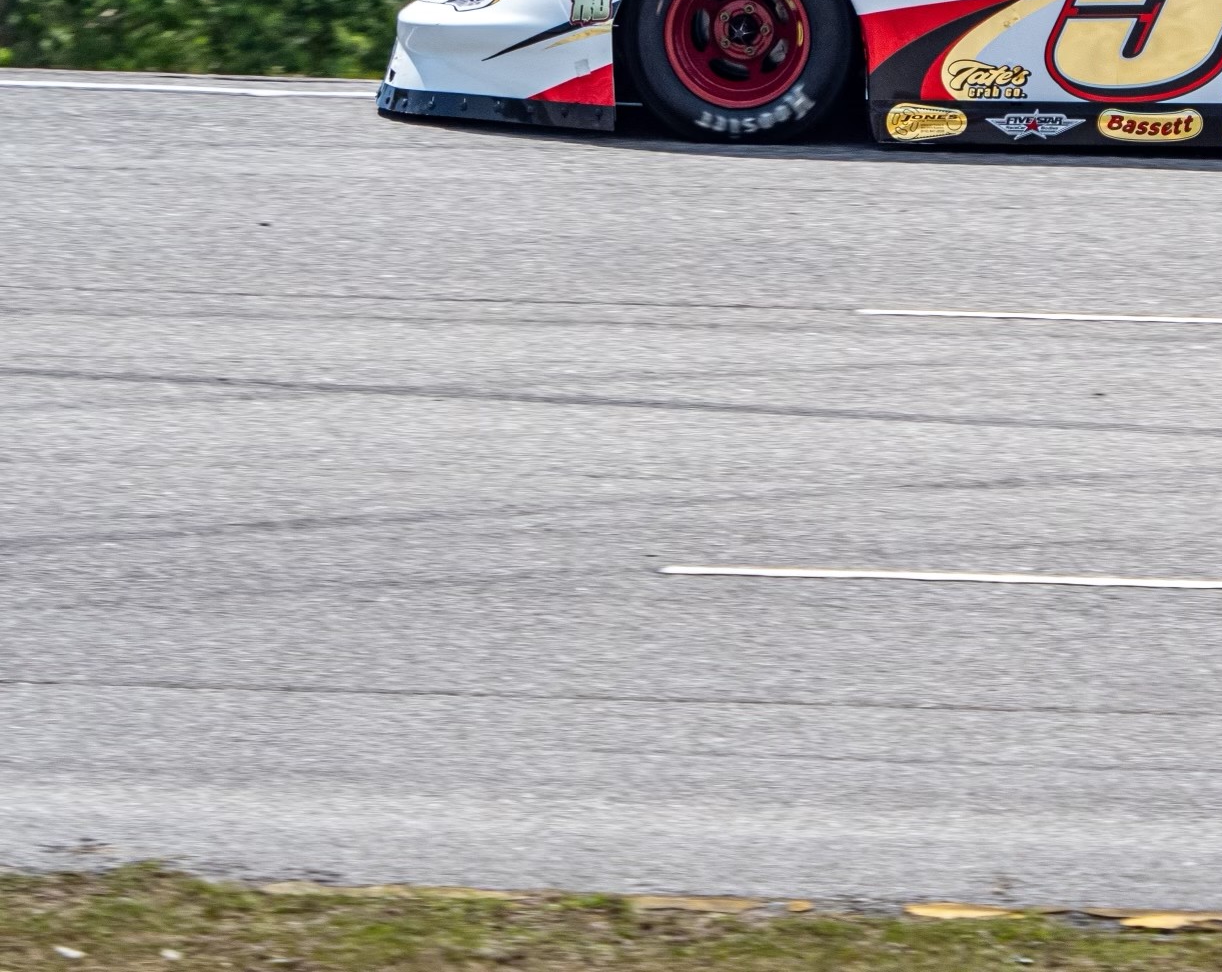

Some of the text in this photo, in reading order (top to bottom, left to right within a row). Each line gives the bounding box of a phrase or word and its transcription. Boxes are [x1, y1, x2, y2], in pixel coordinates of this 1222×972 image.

[948, 59, 1032, 91] Tate's
[1006, 116, 1064, 125] FIVE STAR
[1106, 114, 1195, 136] Bassett
